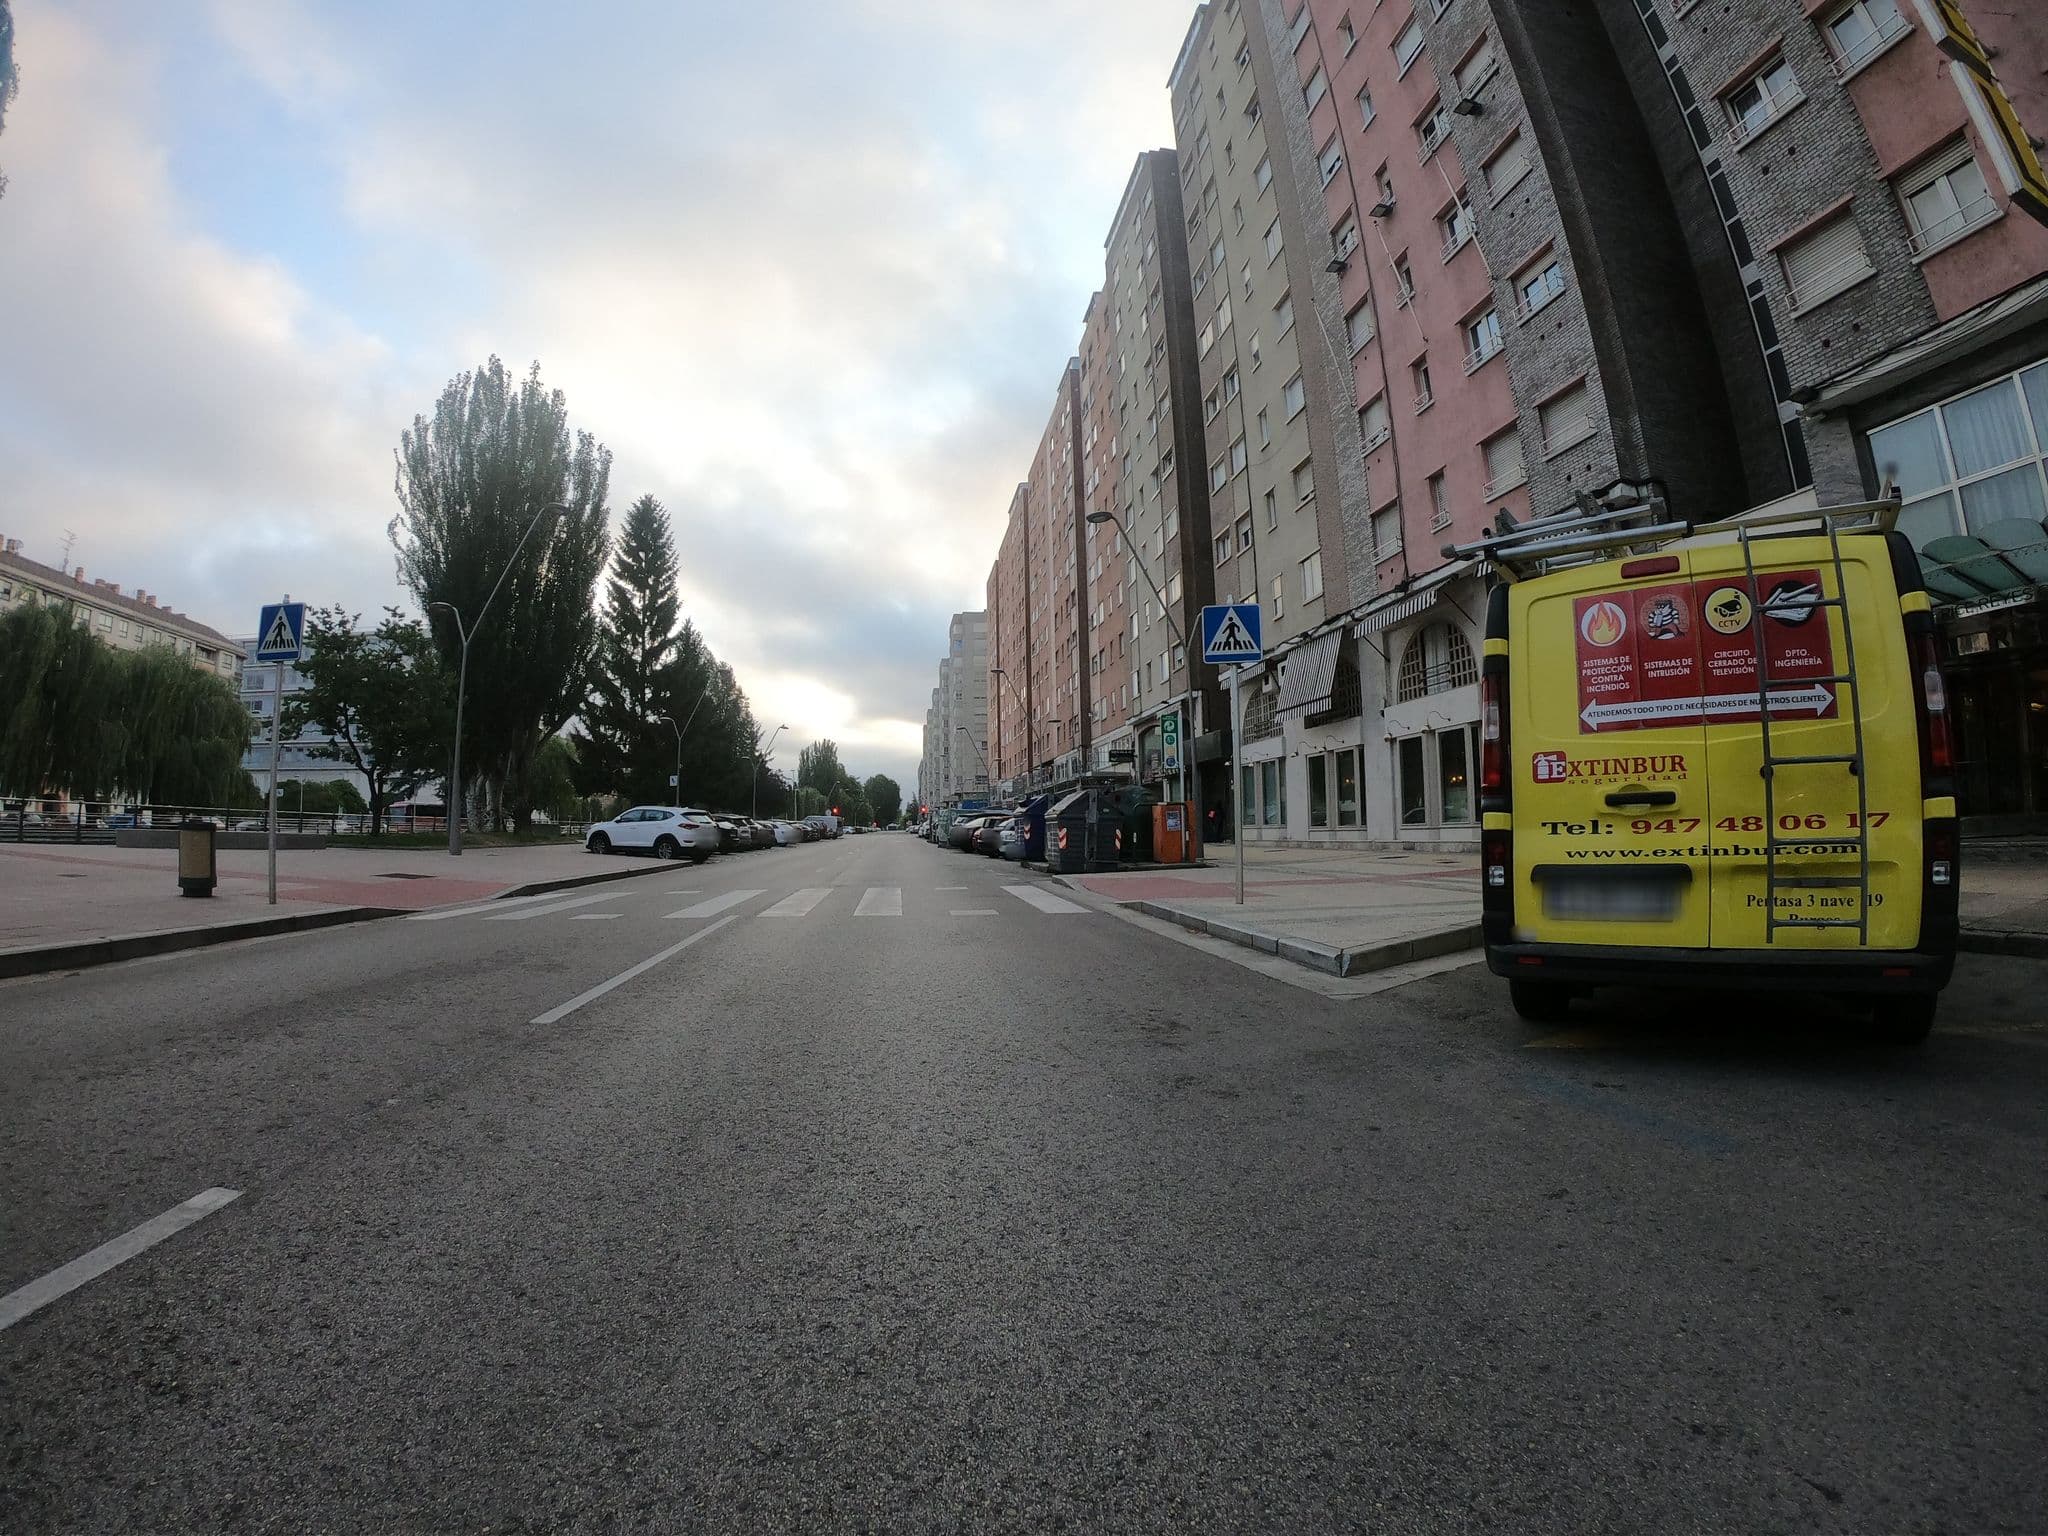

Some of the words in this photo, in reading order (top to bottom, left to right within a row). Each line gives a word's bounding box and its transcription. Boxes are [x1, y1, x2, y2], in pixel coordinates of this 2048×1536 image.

[1718, 619, 1741, 628] CCTV
[1714, 649, 1750, 659] CIRCUITO
[1785, 649, 1810, 657] DPTO.
[1583, 657, 1619, 668] SISTEMAS
[1619, 656, 1630, 664] DE
[1643, 660, 1681, 670] SISTEMAS
[1682, 658, 1693, 666] DE
[1708, 659, 1745, 668] CERRADO
[1747, 657, 1758, 665] DE
[1775, 657, 1823, 667] INGENIERÍA
[1582, 664, 1633, 677] PROTECCIÓN
[1648, 667, 1690, 678] INTRUSIÓN
[1713, 665, 1755, 676] TELEVISIÓN
[1591, 675, 1625, 684] CONTRA
[1586, 682, 1631, 693] INCENDIOS
[1587, 708, 1632, 718] ATENDEMOS
[1633, 706, 1654, 714] TODO
[1656, 704, 1673, 712] TIPO
[1674, 703, 1684, 711] DE
[1685, 700, 1737, 710] NECESIDADES
[1749, 696, 1791, 705] NUSTROS
[1791, 694, 1827, 703] CLIENTES
[1551, 755, 1688, 778] EXTINBUR
[1567, 773, 1688, 785] seguridad
[1541, 819, 1614, 835] Tel:
[1631, 818, 1701, 835] 947
[1715, 816, 1764, 832] 48
[1778, 814, 1827, 831] 06
[1845, 812, 1890, 829] 17
[1566, 843, 1860, 859] www.extinbur.com
[1807, 894, 1815, 907] 3
[1820, 896, 1855, 907] nave
